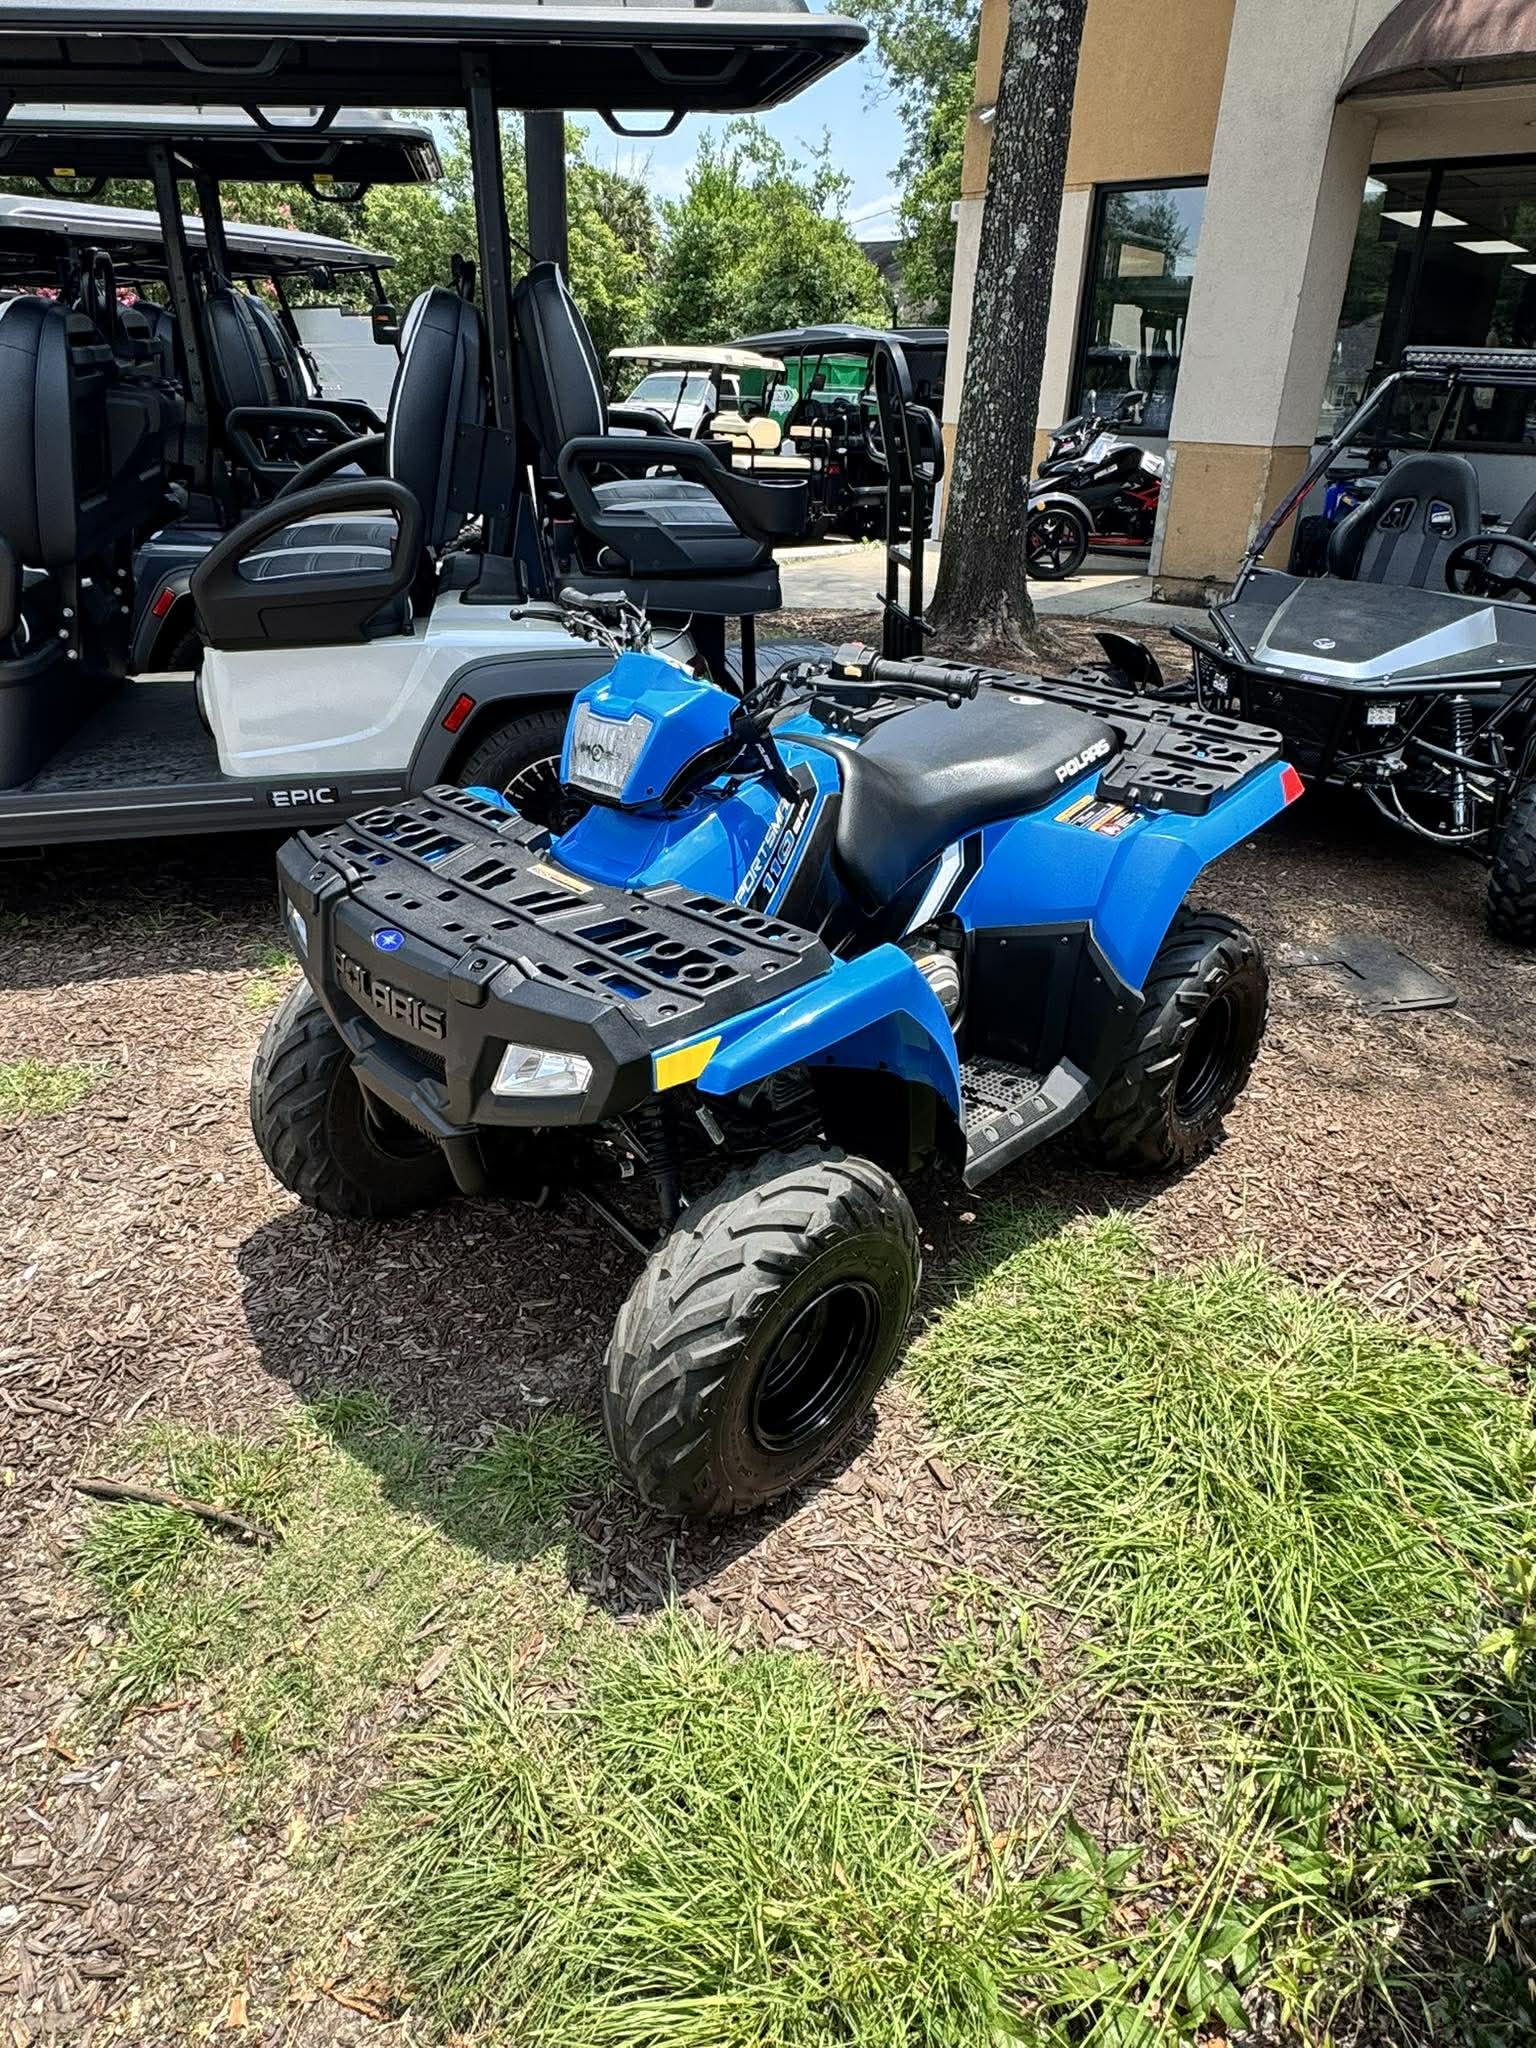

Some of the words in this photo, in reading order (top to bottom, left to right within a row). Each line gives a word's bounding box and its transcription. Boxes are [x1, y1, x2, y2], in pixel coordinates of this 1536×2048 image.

[1054, 738, 1111, 783] POLARIS
[271, 787, 335, 807] EPIC
[733, 797, 793, 907] PORTSMA
[762, 829, 795, 894] 110
[334, 944, 447, 1041] POLARIS
